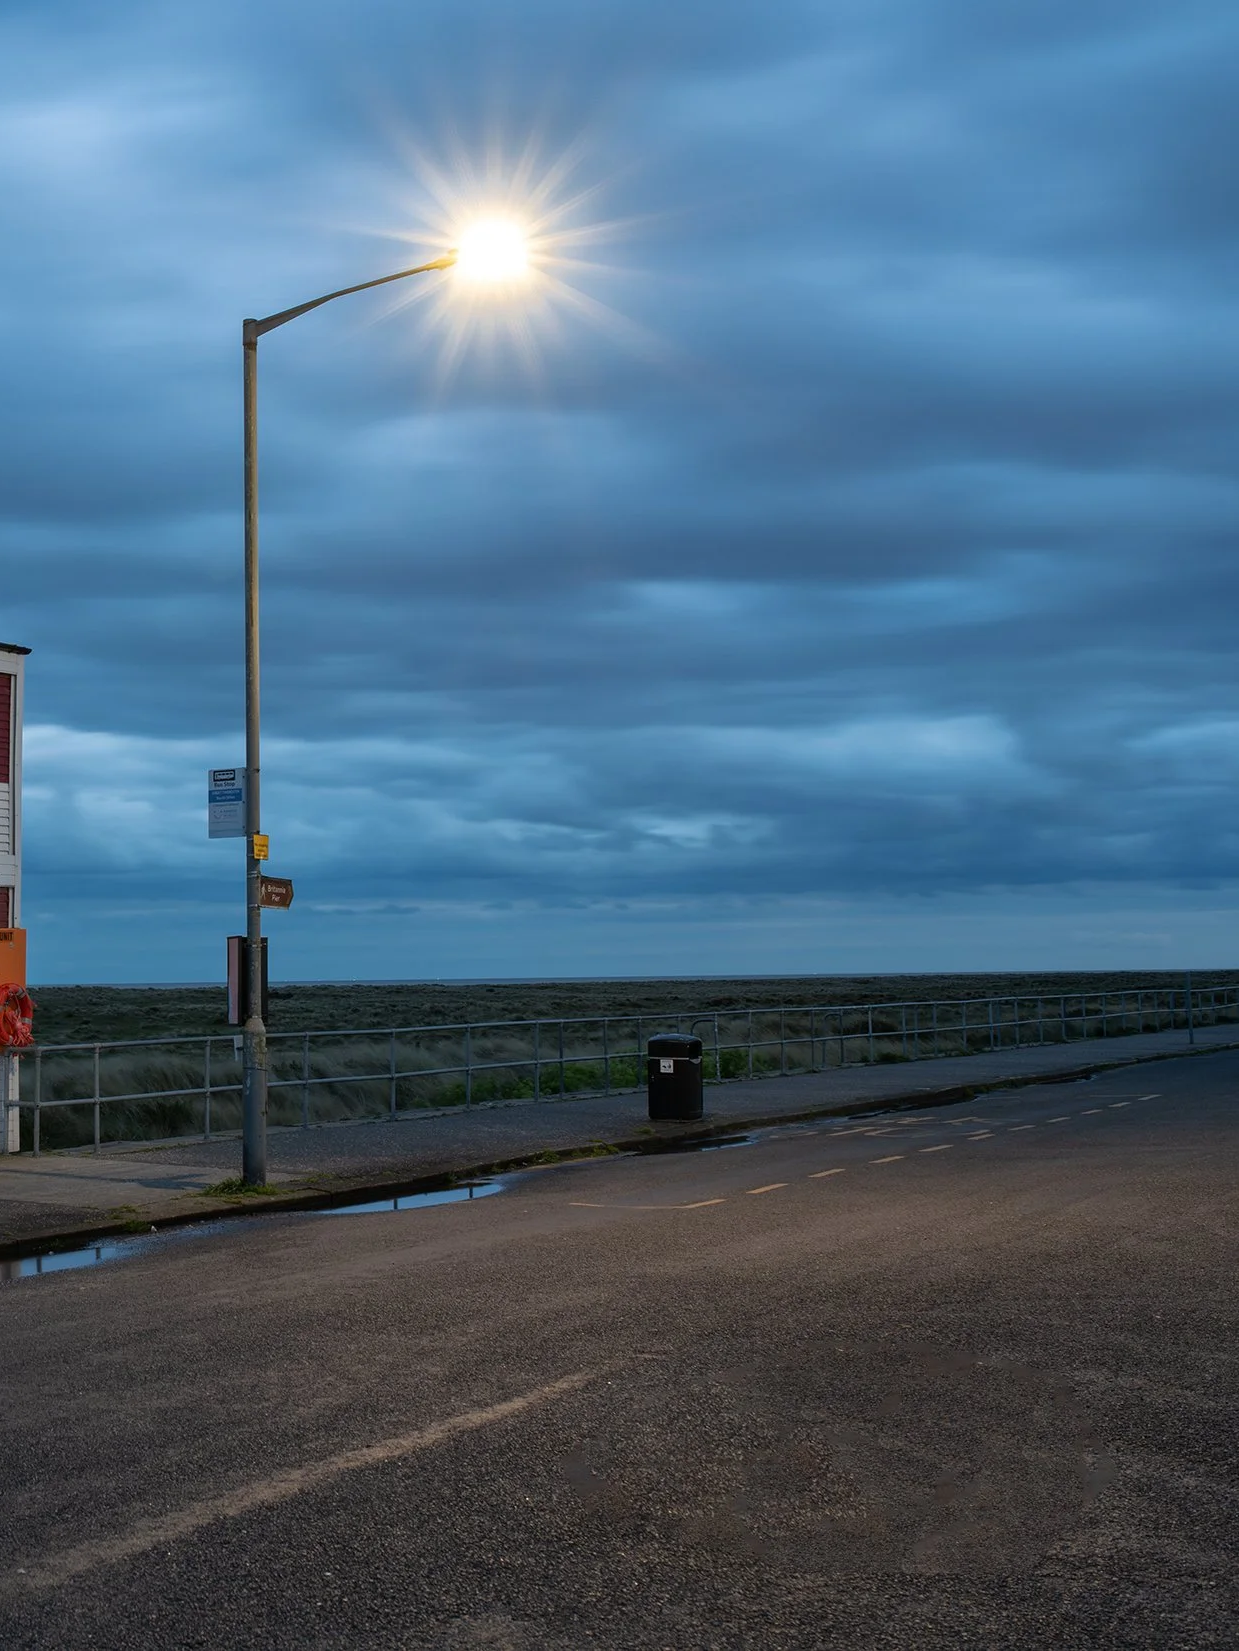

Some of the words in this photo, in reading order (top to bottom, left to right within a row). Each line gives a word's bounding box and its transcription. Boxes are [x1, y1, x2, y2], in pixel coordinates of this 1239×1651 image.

[268, 884, 286, 894] Britannia
[272, 894, 280, 902] Pier
[0, 932, 14, 941] UNIT
